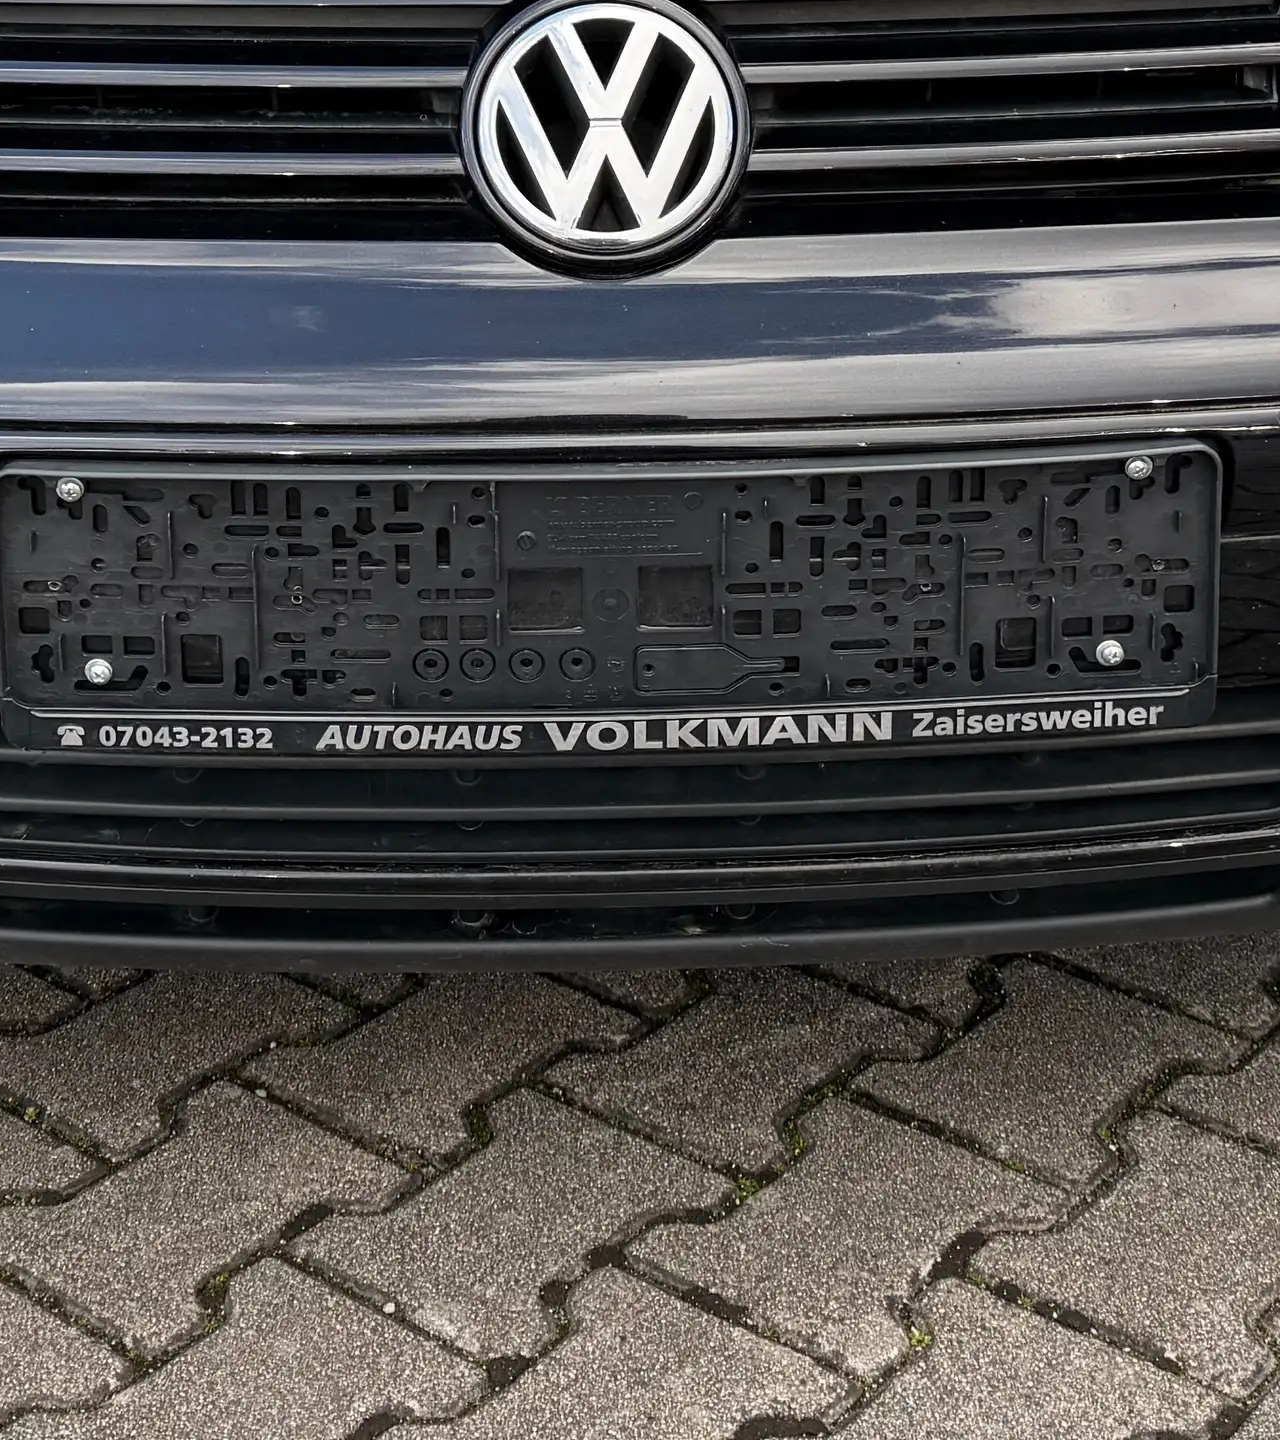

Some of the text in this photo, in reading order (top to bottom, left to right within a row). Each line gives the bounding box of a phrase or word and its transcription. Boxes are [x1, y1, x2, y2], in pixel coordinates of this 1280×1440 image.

[98, 700, 1165, 752] 07043-2132 AUTOHAUS VOLKMANN Zaisersweiher
